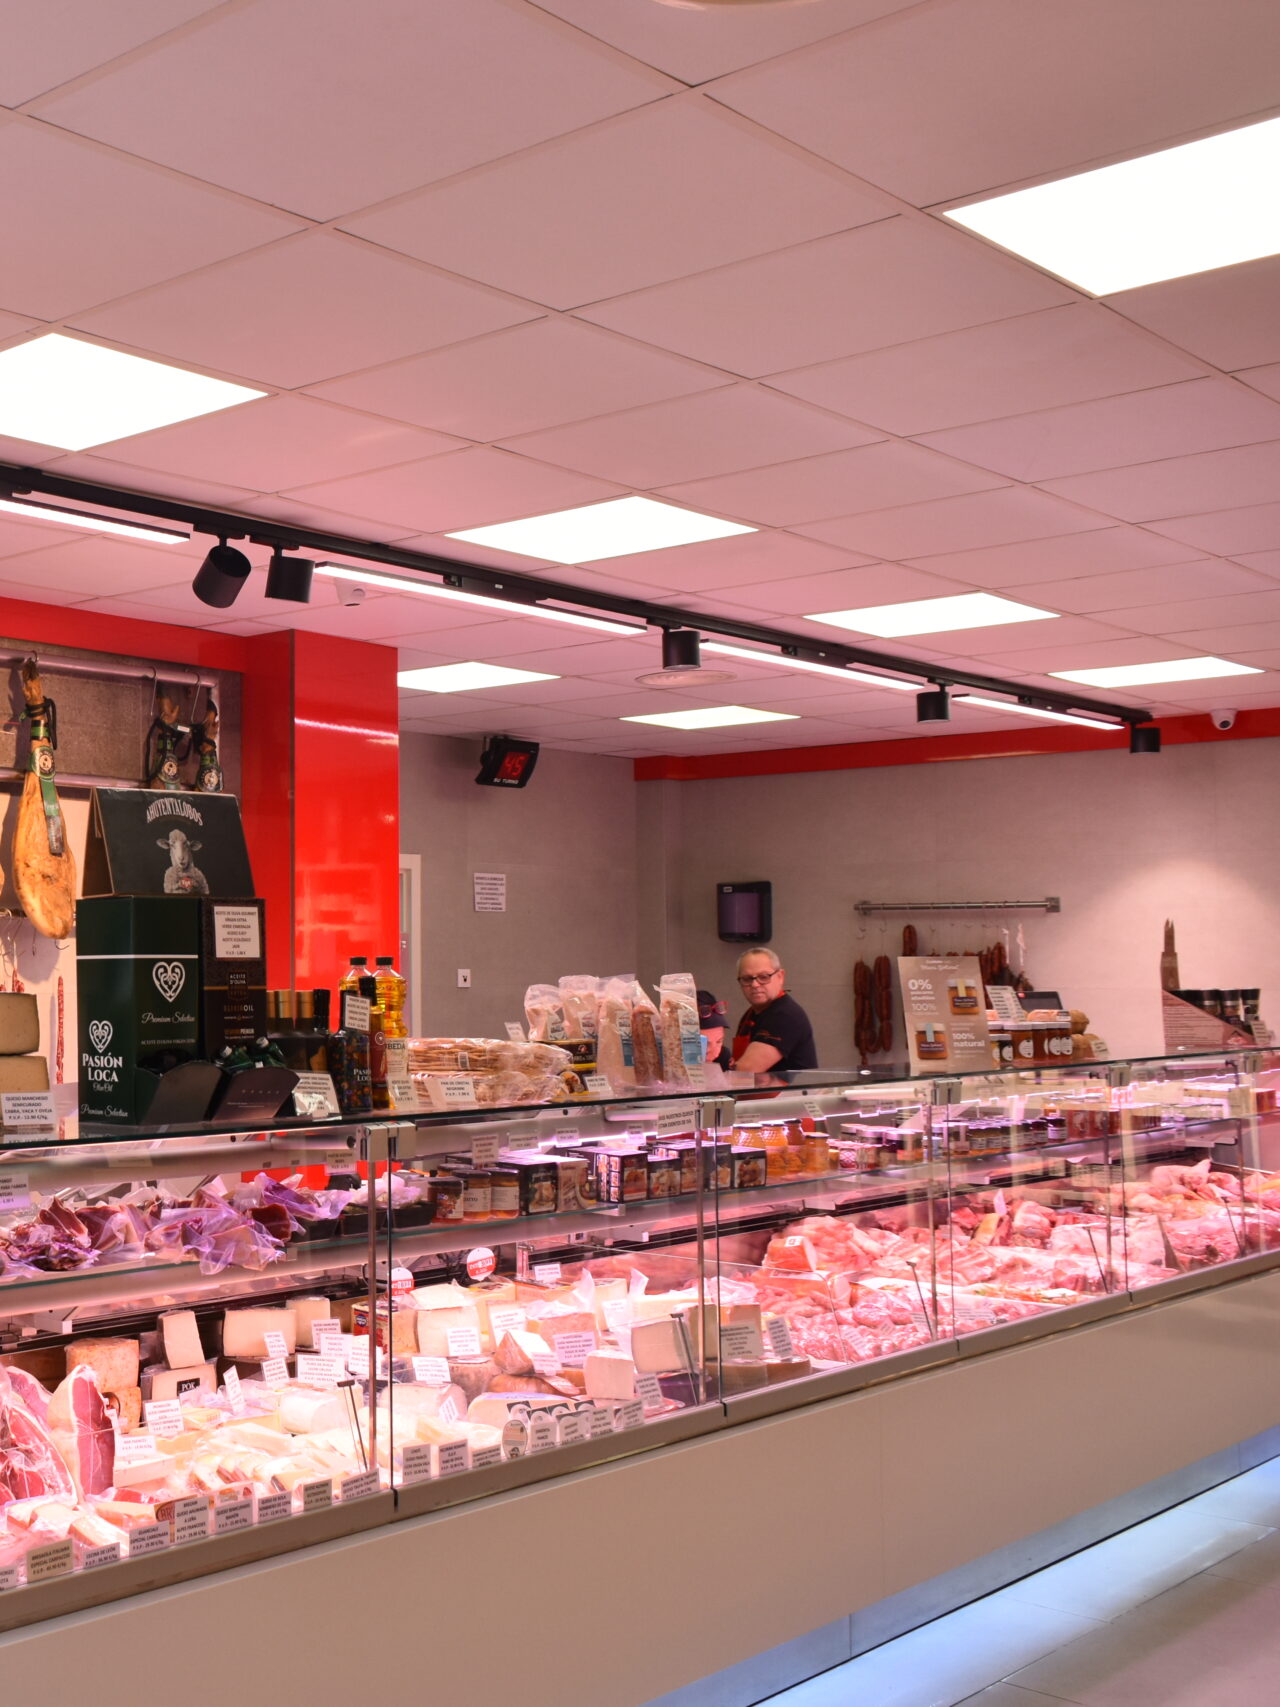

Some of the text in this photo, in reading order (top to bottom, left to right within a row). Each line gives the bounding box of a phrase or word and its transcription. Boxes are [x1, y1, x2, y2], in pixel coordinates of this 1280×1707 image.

[908, 978, 932, 990] 0%
[953, 1039, 985, 1048] natural
[82, 1053, 123, 1069] PASIÓN
[88, 1068, 118, 1083] LOCA
